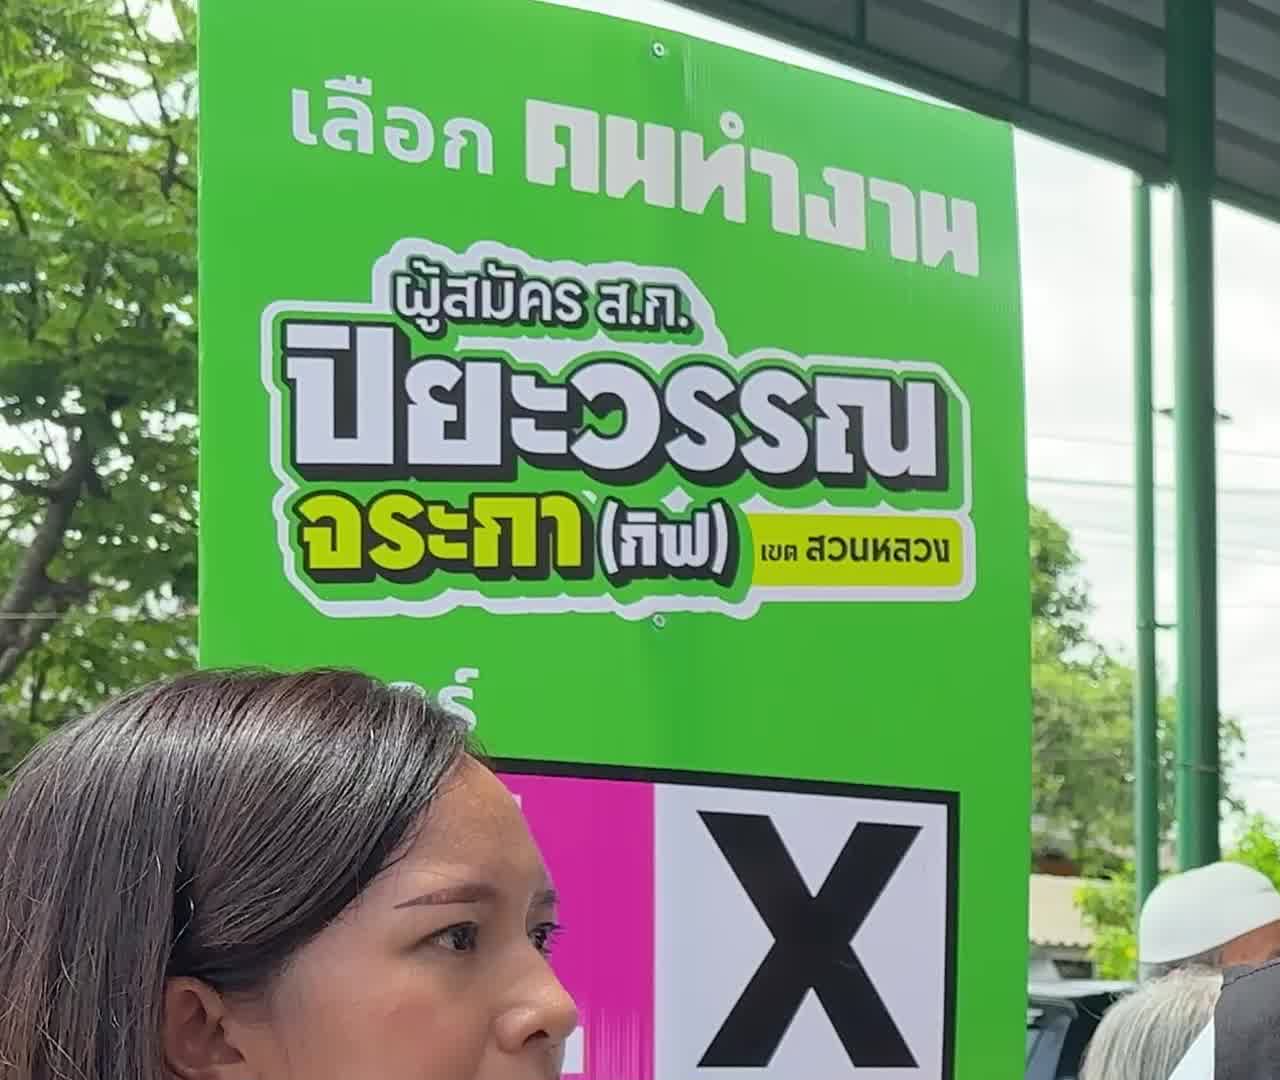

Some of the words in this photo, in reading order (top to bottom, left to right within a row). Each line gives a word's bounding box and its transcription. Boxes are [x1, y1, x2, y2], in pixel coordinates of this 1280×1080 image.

[291, 75, 494, 175] เลือก
[525, 98, 979, 277] คนทำงาน
[395, 260, 584, 333] ผู้สมัคร
[597, 283, 691, 328] ส.ก.
[286, 324, 937, 478] ปิยะวรรณ
[299, 494, 583, 571] จระกา
[601, 499, 729, 575] (กิฟ)
[760, 543, 798, 562] เขต
[806, 535, 950, 563] สวนหลวง
